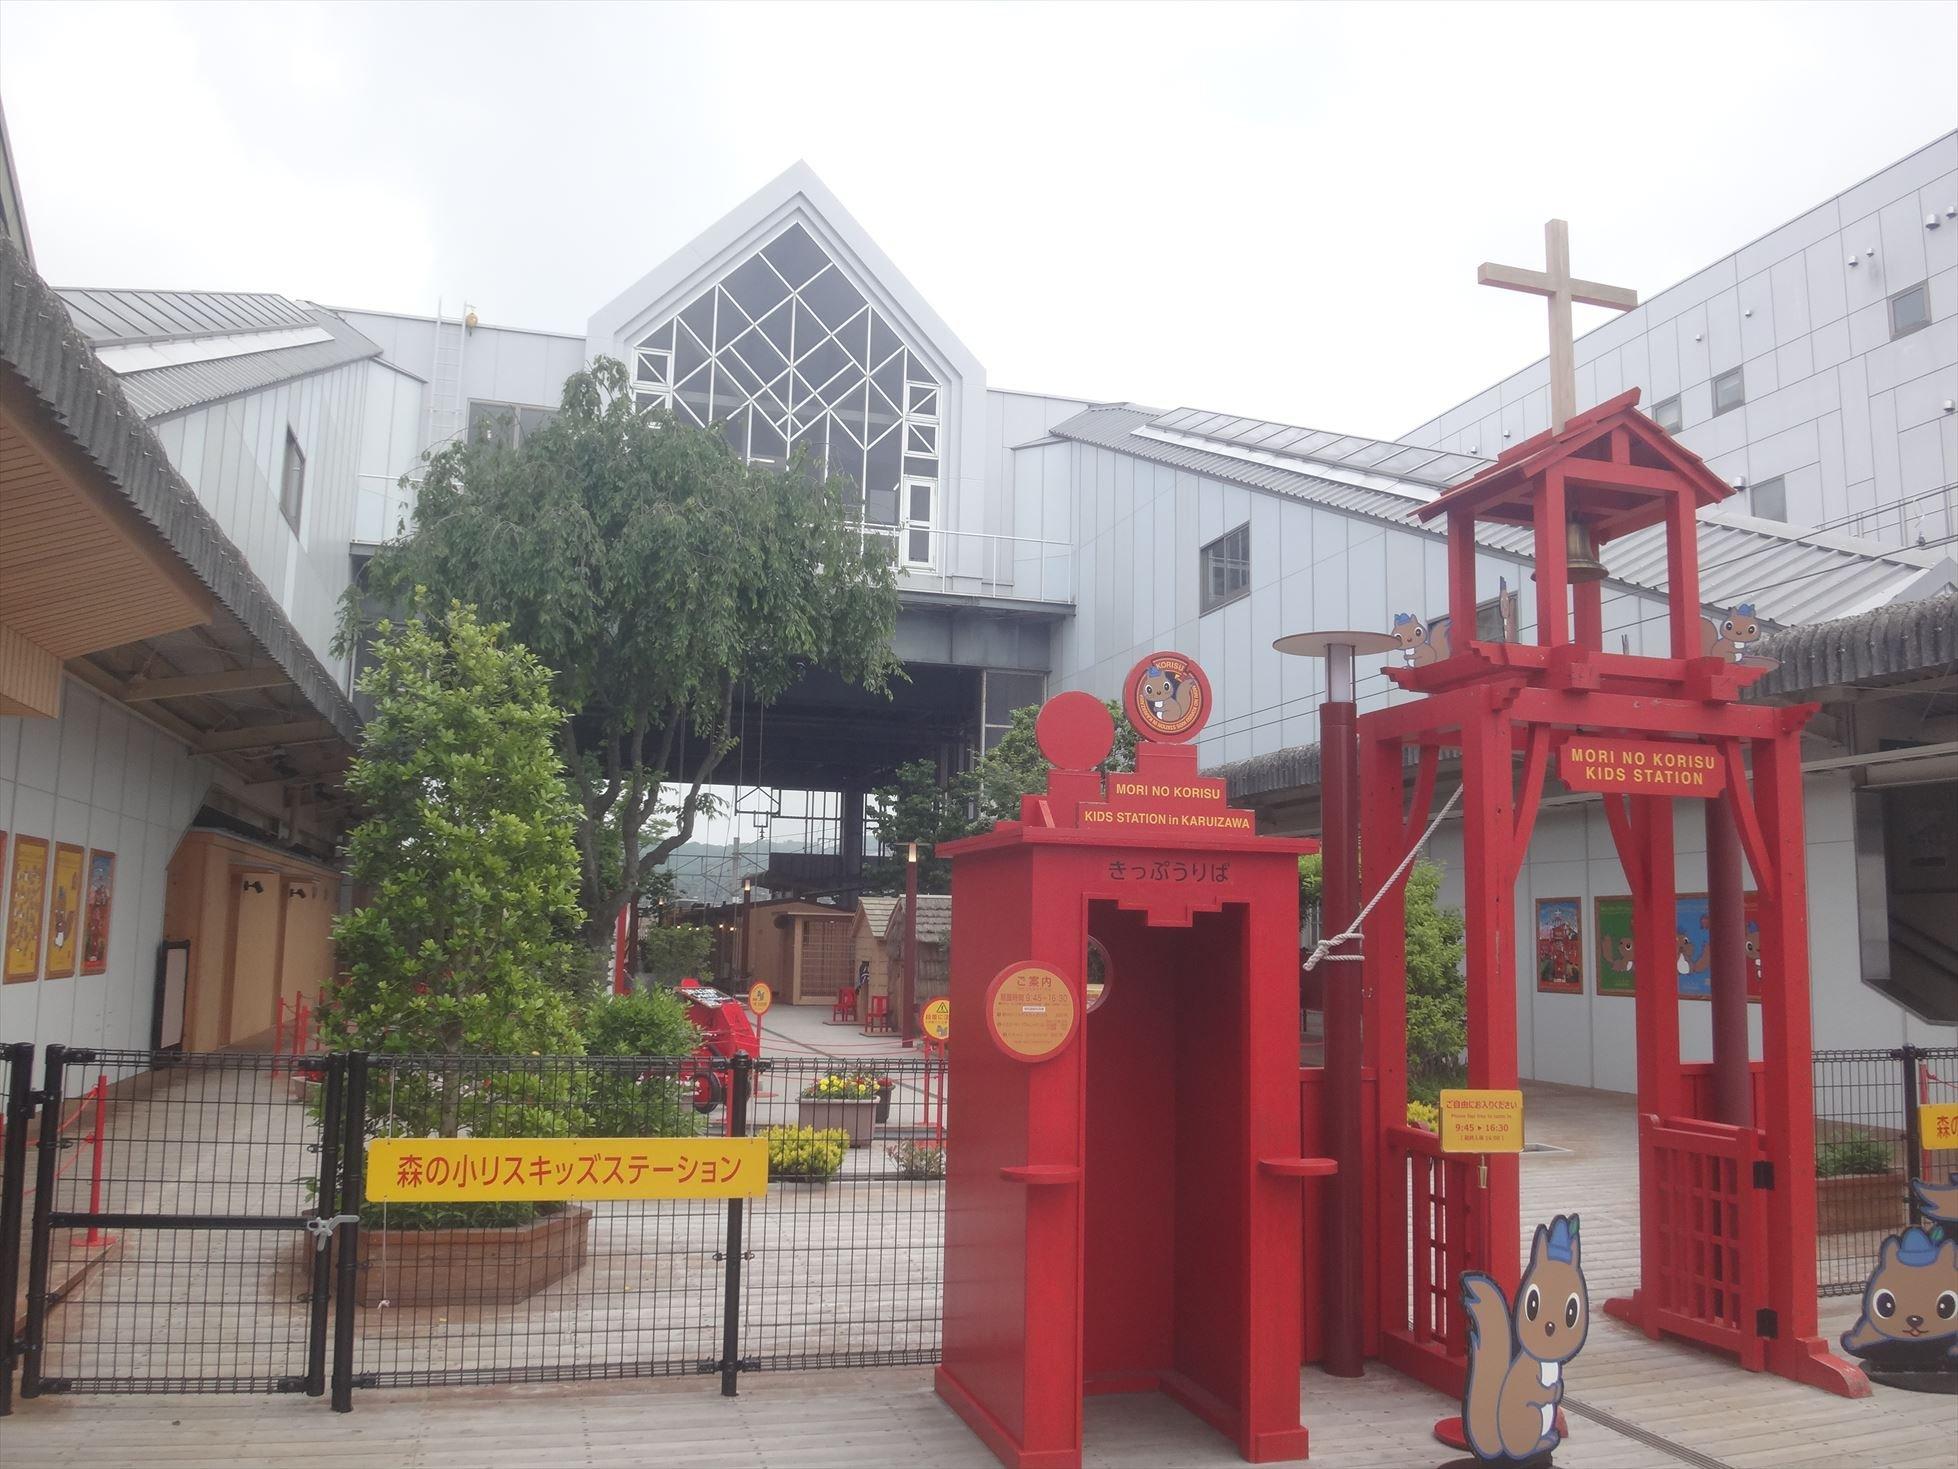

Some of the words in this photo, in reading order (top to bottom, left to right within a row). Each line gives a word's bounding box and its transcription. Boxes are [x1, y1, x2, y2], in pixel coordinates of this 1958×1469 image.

[1156, 661, 1185, 671] KORISU
[1571, 748, 1615, 763] MORI
[1622, 752, 1645, 765] NO
[1653, 753, 1715, 769] KORISU
[1586, 767, 1626, 781] KIDS
[1633, 769, 1703, 785] STATION
[1116, 784, 1148, 796] MORI
[1152, 786, 1170, 797] NO
[1174, 787, 1220, 799] KORISU
[1084, 811, 1113, 823] KIDS
[1116, 812, 1166, 825] STATION
[1168, 814, 1179, 825] in
[1181, 815, 1250, 829] KARUIZAWA
[1108, 861, 1230, 883] きっぷうりば
[1016, 976, 1052, 988] ご案内
[1446, 1100, 1518, 1110] ご自由にお入りください
[1455, 1124, 1474, 1132] 9:45
[1486, 1124, 1509, 1132] 16:30
[397, 1153, 742, 1188] 森の小リスキッズステーション
